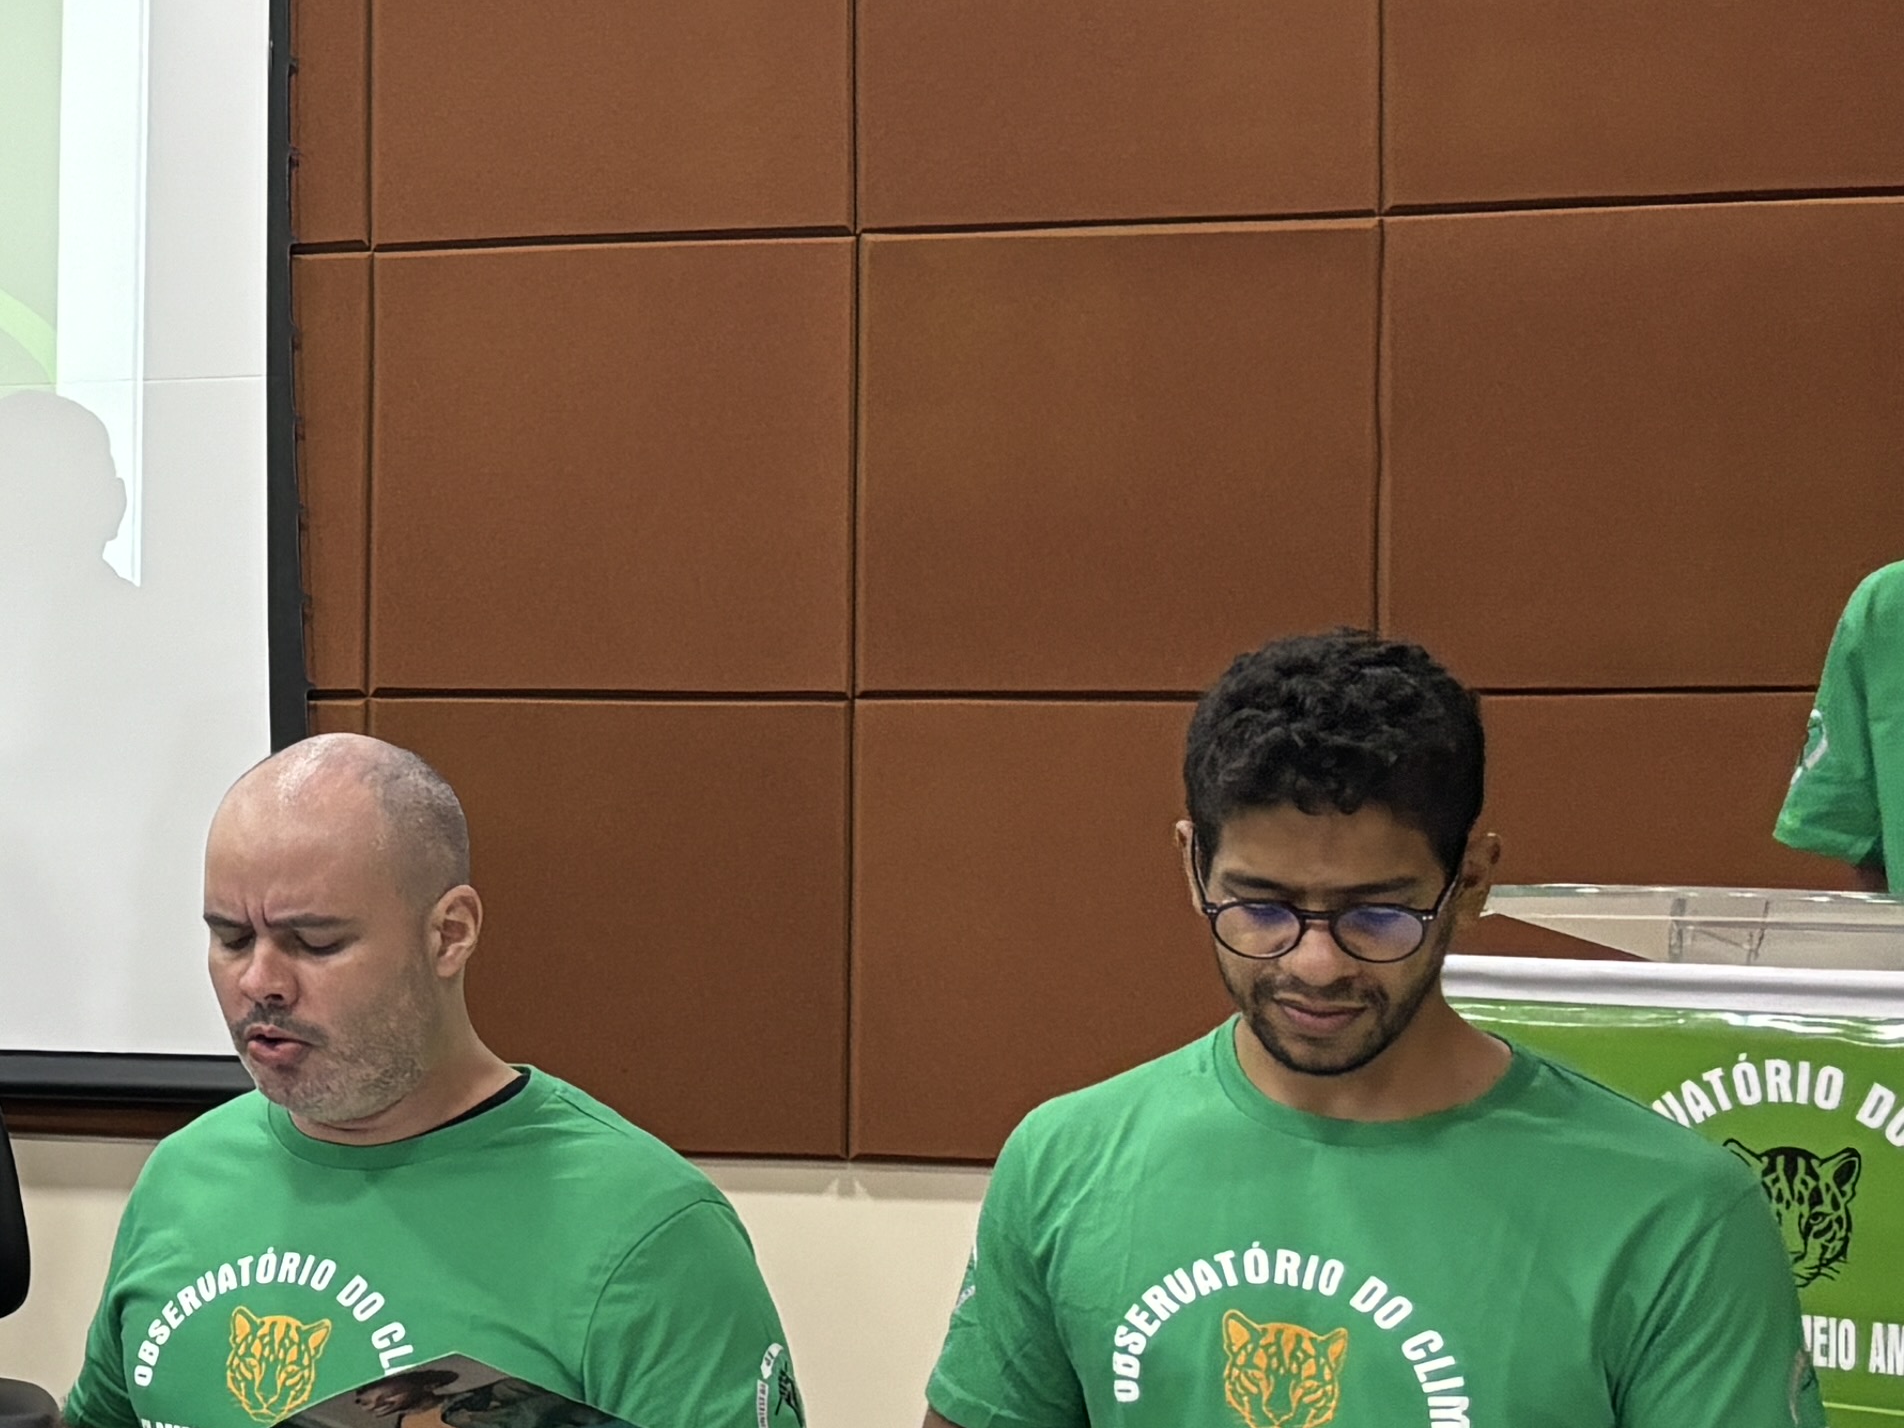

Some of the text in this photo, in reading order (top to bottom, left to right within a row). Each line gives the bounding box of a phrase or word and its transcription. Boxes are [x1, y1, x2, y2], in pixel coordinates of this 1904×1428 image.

[134, 1246, 337, 1387] OBSERVATÓRIO
[336, 1275, 385, 1322] DO
[1112, 1241, 1344, 1403] OBSERVATÓRIO
[1349, 1276, 1413, 1330] DO
